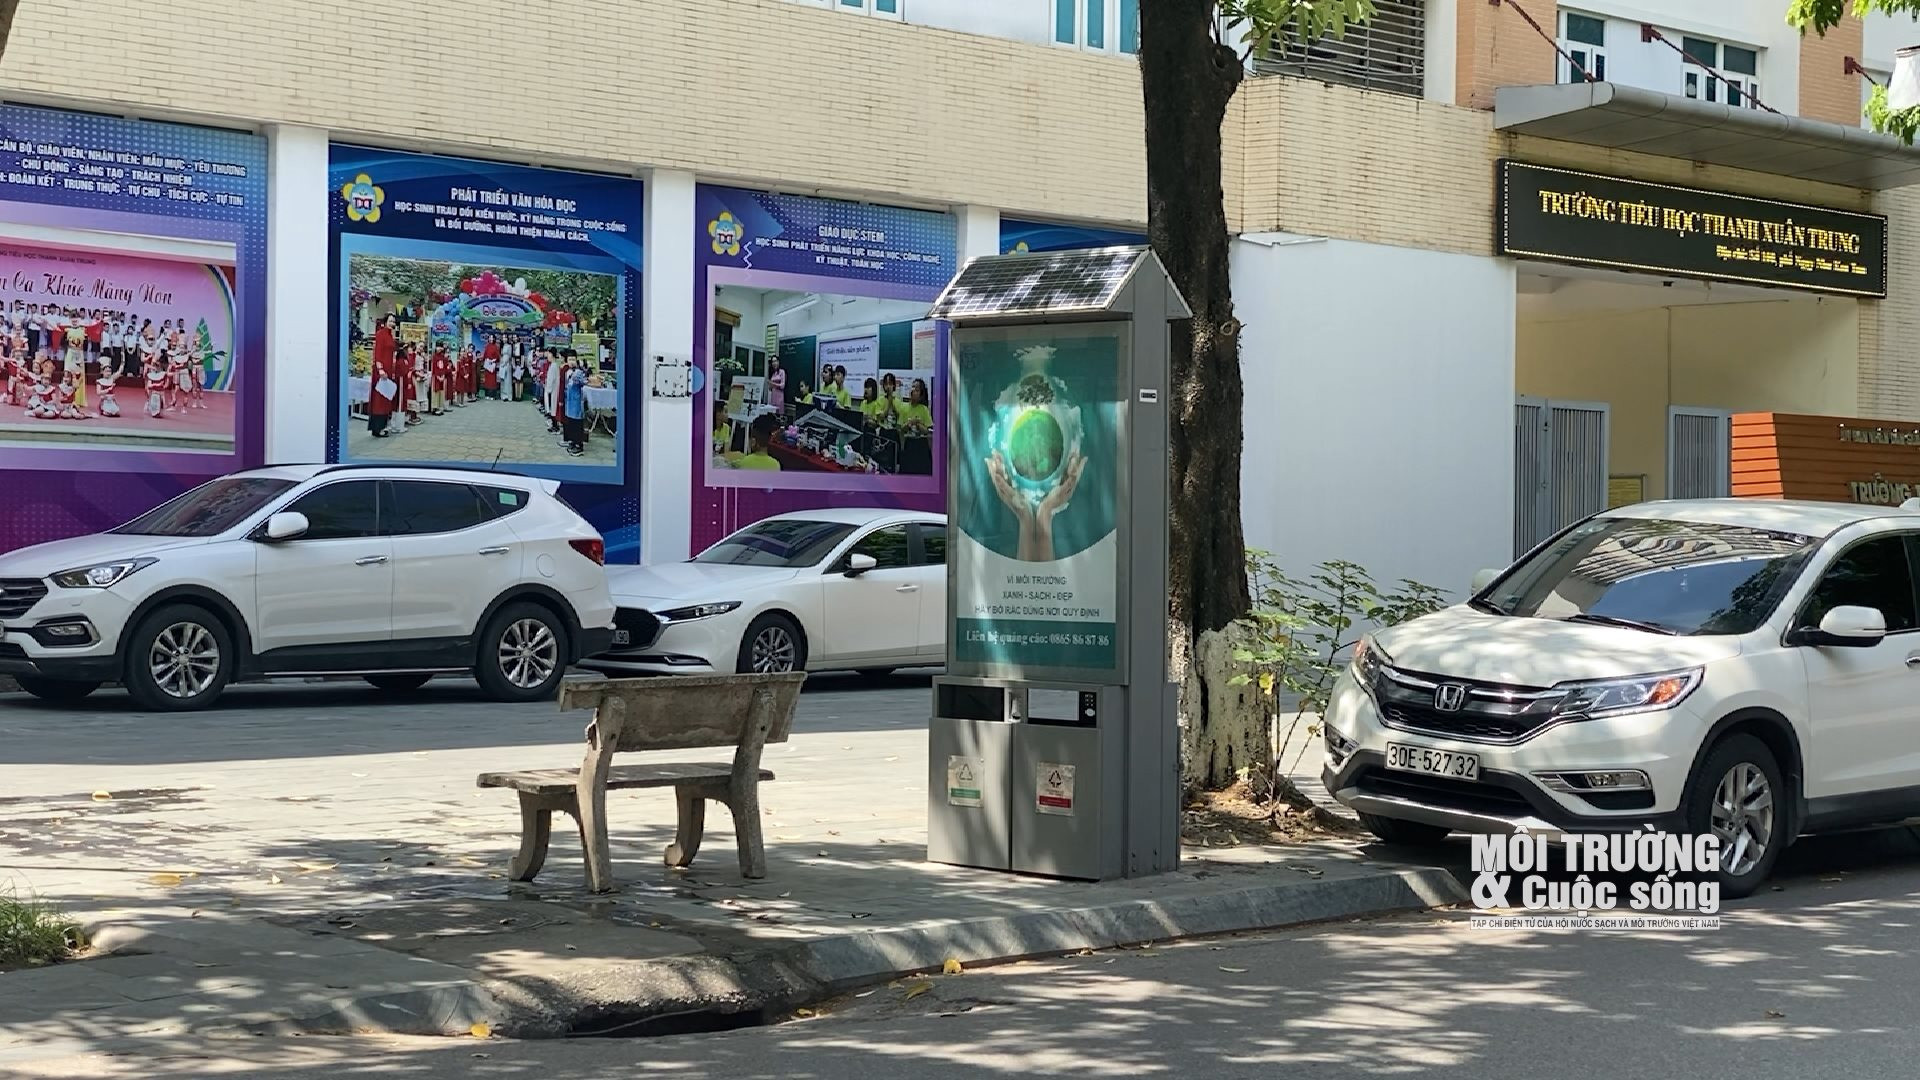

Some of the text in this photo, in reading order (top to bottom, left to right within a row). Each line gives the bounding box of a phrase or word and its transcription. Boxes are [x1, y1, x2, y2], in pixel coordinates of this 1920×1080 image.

[37, 143, 60, 156] GIÁO
[88, 149, 114, 162] NHÂN
[194, 160, 210, 173] YÊU
[43, 159, 69, 173] ĐỘNG
[79, 163, 104, 176] SÁNG
[106, 167, 123, 180] TẠO
[132, 169, 161, 183] TRÁCH
[163, 172, 192, 187] NHIỆM
[9, 172, 35, 185] ĐOÀN
[37, 173, 55, 187] KẾT
[64, 178, 94, 191] TRUNG
[96, 180, 120, 194] THỰC
[168, 187, 188, 200] TÍCH
[190, 191, 208, 204] CỰC
[229, 195, 244, 206] TIN
[451, 187, 576, 214] PHÁT TRIỂN VĂN HÓA ĐỌC
[394, 201, 412, 213] HỌC
[414, 202, 435, 214] SINH
[436, 205, 457, 216] TRAU
[475, 207, 493, 219] KIẾN
[532, 213, 555, 226] NĂNG
[556, 217, 582, 228] TRONG
[584, 219, 604, 231] CUỘC
[605, 220, 627, 233] SỐNG
[435, 217, 445, 228] VÀ
[495, 223, 518, 235] HOÀN
[520, 226, 542, 239] THIỆN
[544, 228, 565, 240] NHÂN
[1539, 190, 1860, 254] TRƯỜNG TIỂU HỌC THANH XUÂN TRUNG
[818, 225, 884, 243] GIÁO DỤC STEM
[755, 237, 770, 247] HỌC
[772, 238, 789, 248] SINH
[791, 240, 808, 250] PHÁT
[867, 248, 884, 258] KHOA
[871, 260, 884, 270] HỌC
[39, 273, 85, 297] Khúc
[1851, 472, 1912, 504] TRƯỜNG
[1015, 574, 1030, 585] MÔI
[1032, 574, 1067, 586] TRƯỜNG
[1003, 591, 1023, 601] XANH
[1029, 591, 1051, 602] SẠCH
[1063, 607, 1079, 618] QUY
